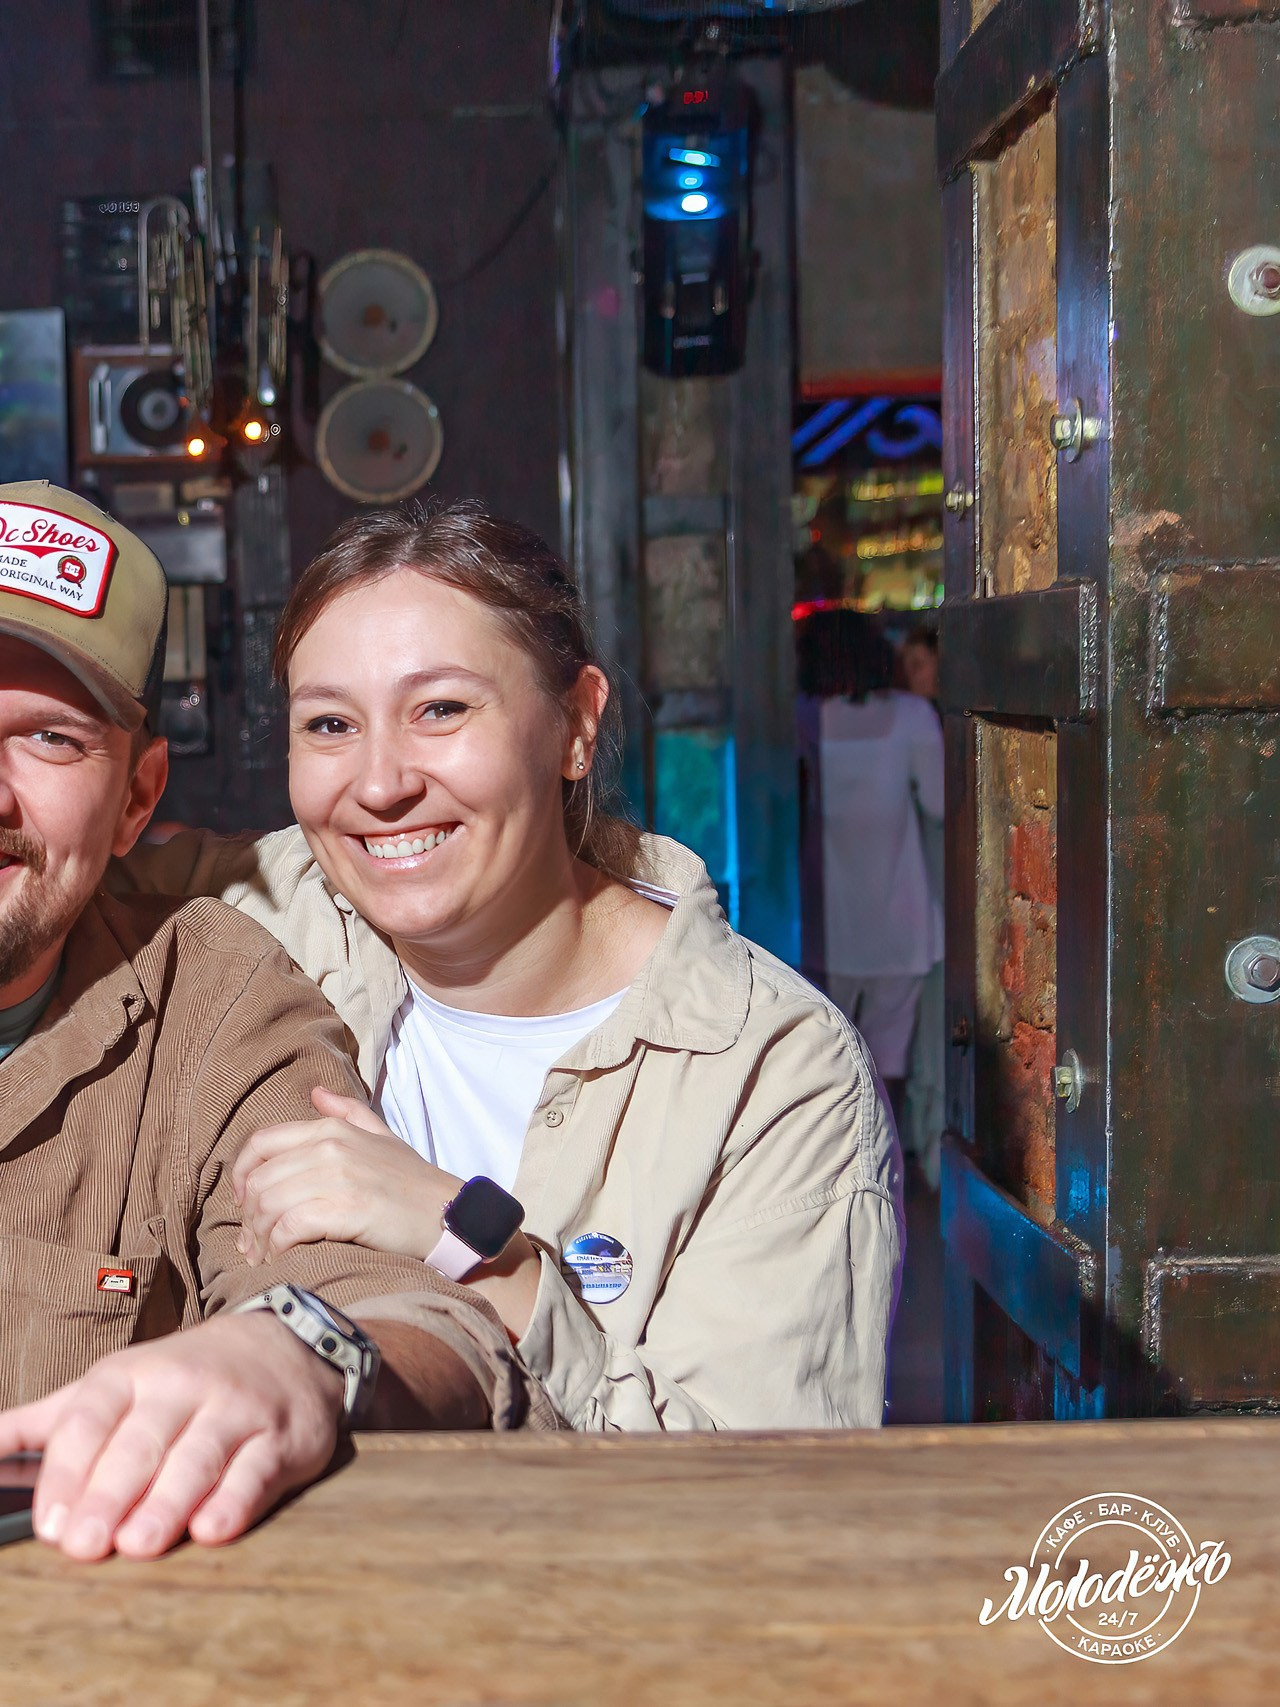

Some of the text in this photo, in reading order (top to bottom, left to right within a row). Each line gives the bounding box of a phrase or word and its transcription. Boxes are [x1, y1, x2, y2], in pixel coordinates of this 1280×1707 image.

[22, 518, 101, 552] Shoes
[0, 567, 57, 591] ORIGINAL
[60, 585, 83, 601] WAY
